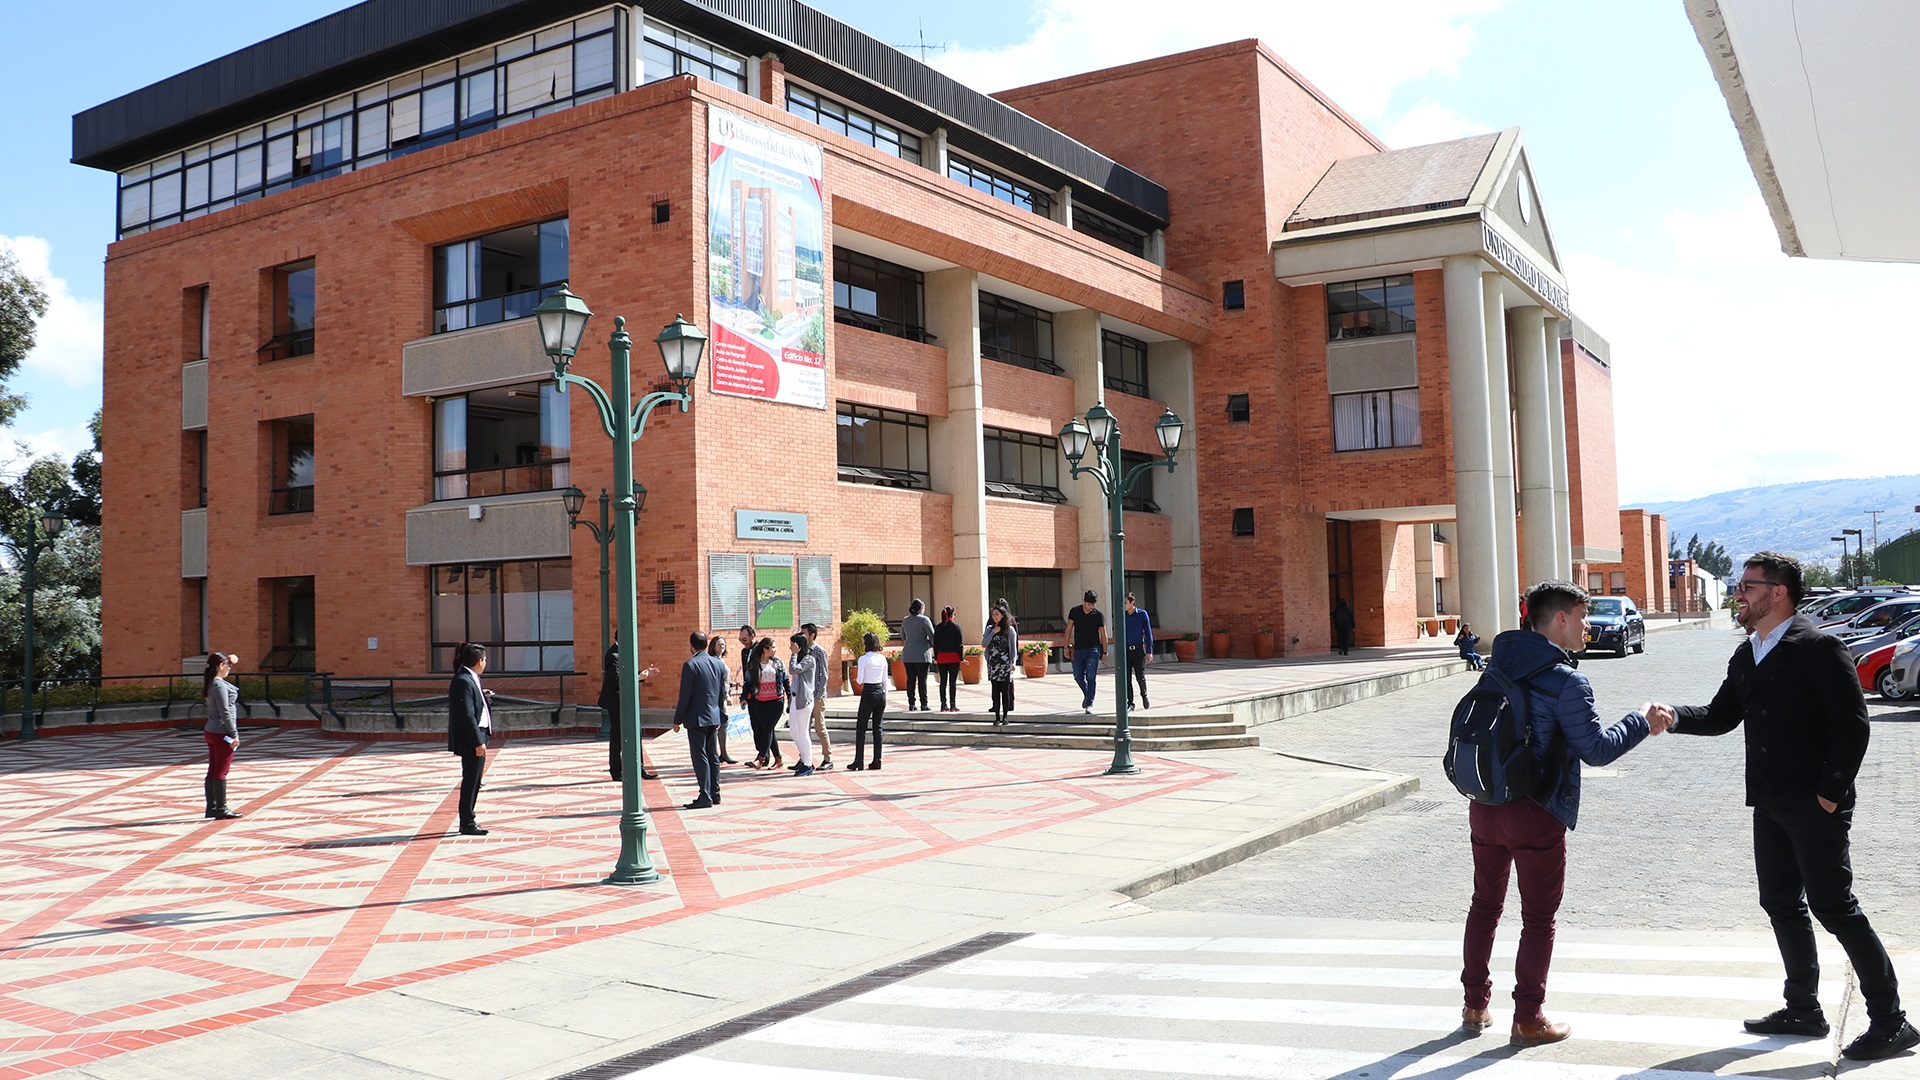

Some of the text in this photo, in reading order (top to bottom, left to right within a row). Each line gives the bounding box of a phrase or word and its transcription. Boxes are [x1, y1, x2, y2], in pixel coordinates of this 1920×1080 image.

[735, 126, 778, 153] Universidad
[779, 145, 789, 157] de
[1484, 224, 1537, 288] UNIVERSIDAD
[1537, 272, 1547, 297] DE
[784, 351, 821, 365] Edificio No. 12
